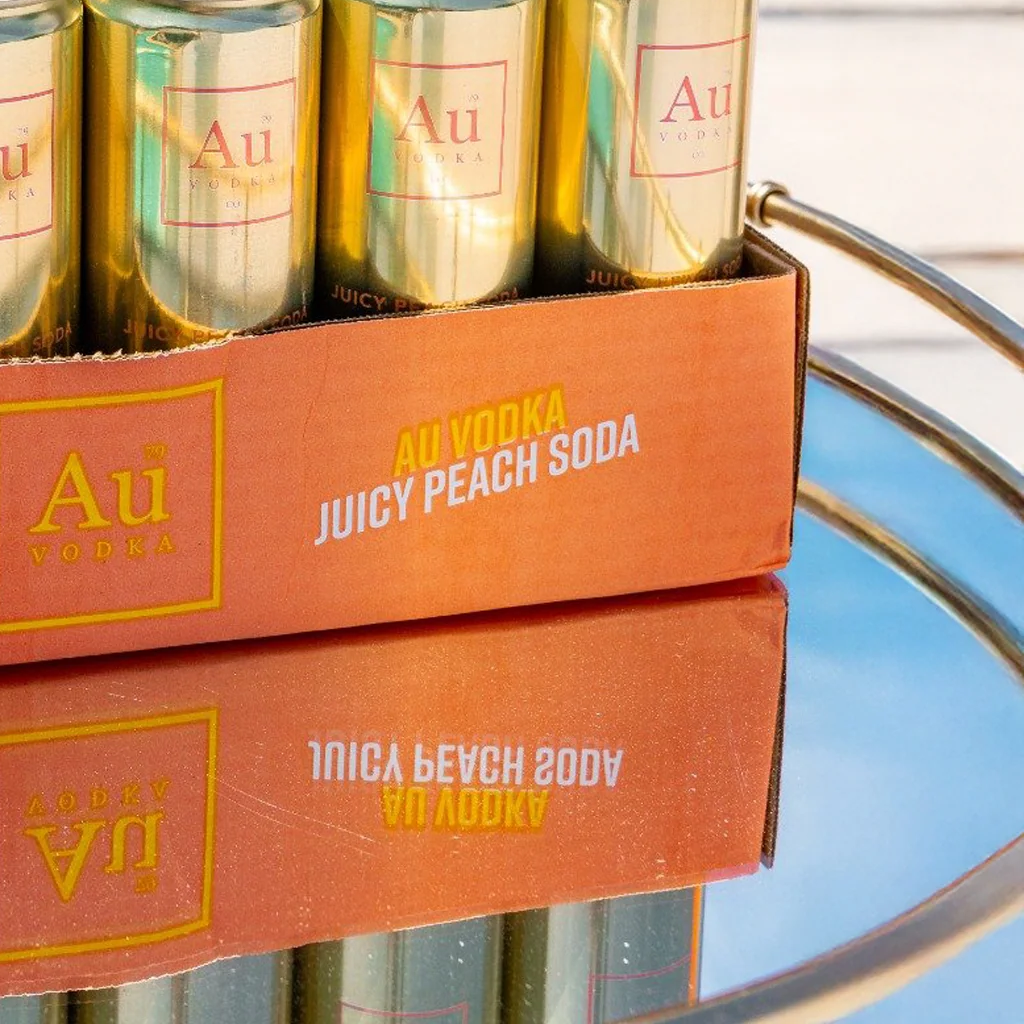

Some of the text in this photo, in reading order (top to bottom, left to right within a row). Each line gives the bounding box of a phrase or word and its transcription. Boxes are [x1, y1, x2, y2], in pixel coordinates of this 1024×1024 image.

[394, 96, 481, 144] Au
[660, 76, 732, 122] Au
[188, 120, 273, 168] Au
[331, 285, 387, 311] JUICY
[394, 388, 566, 476] AU VODKA
[29, 451, 170, 533] Au
[314, 413, 640, 546] JUICY PEACH SODA
[29, 534, 174, 564] VODKA
